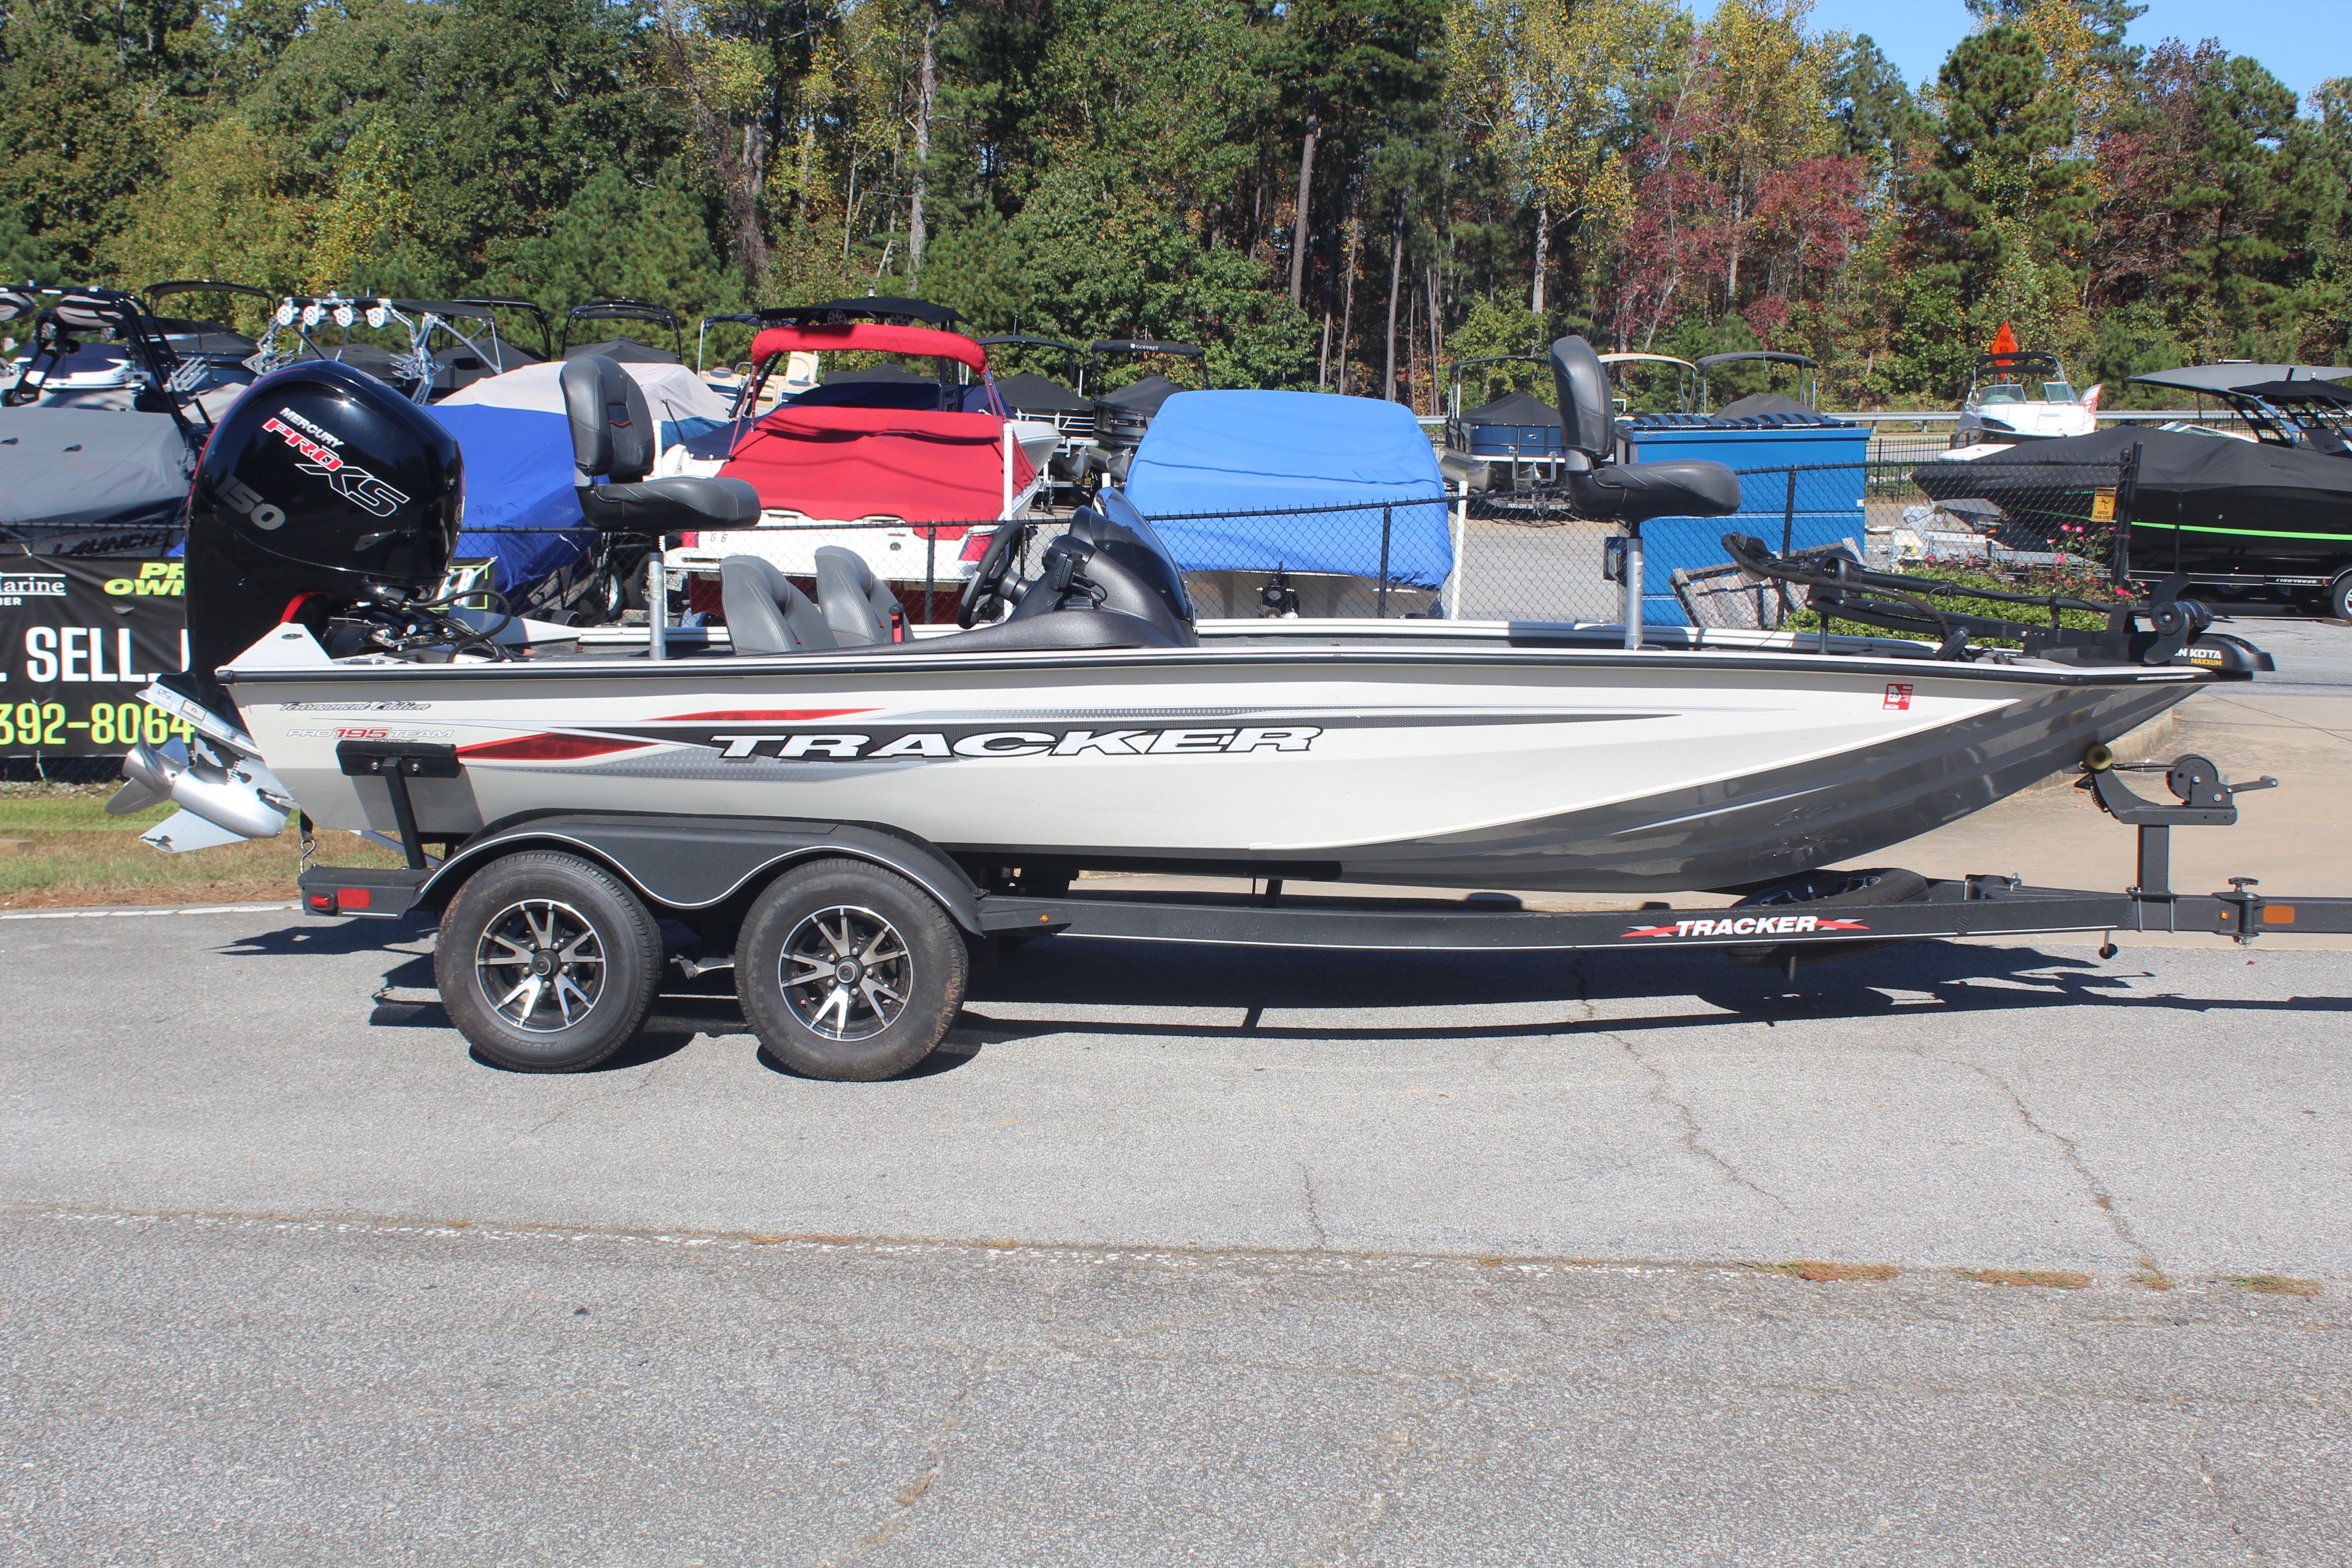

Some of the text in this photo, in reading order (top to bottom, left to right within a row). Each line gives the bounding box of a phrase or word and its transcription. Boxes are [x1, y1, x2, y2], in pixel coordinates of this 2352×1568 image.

[279, 407, 345, 448] MERCURY
[262, 417, 343, 471] PRO
[295, 447, 410, 517] XS
[214, 475, 285, 530] 150
[0, 577, 65, 593] arine
[2189, 648, 2222, 660] KOTA
[2190, 658, 2222, 666] MAXXUM
[279, 701, 431, 711] Tournament Edition
[0, 703, 195, 745] 392-8064
[286, 727, 454, 740] PRO 195 TEAM
[710, 726, 1323, 758] TRACKER
[1675, 916, 1818, 938] TRACKER
